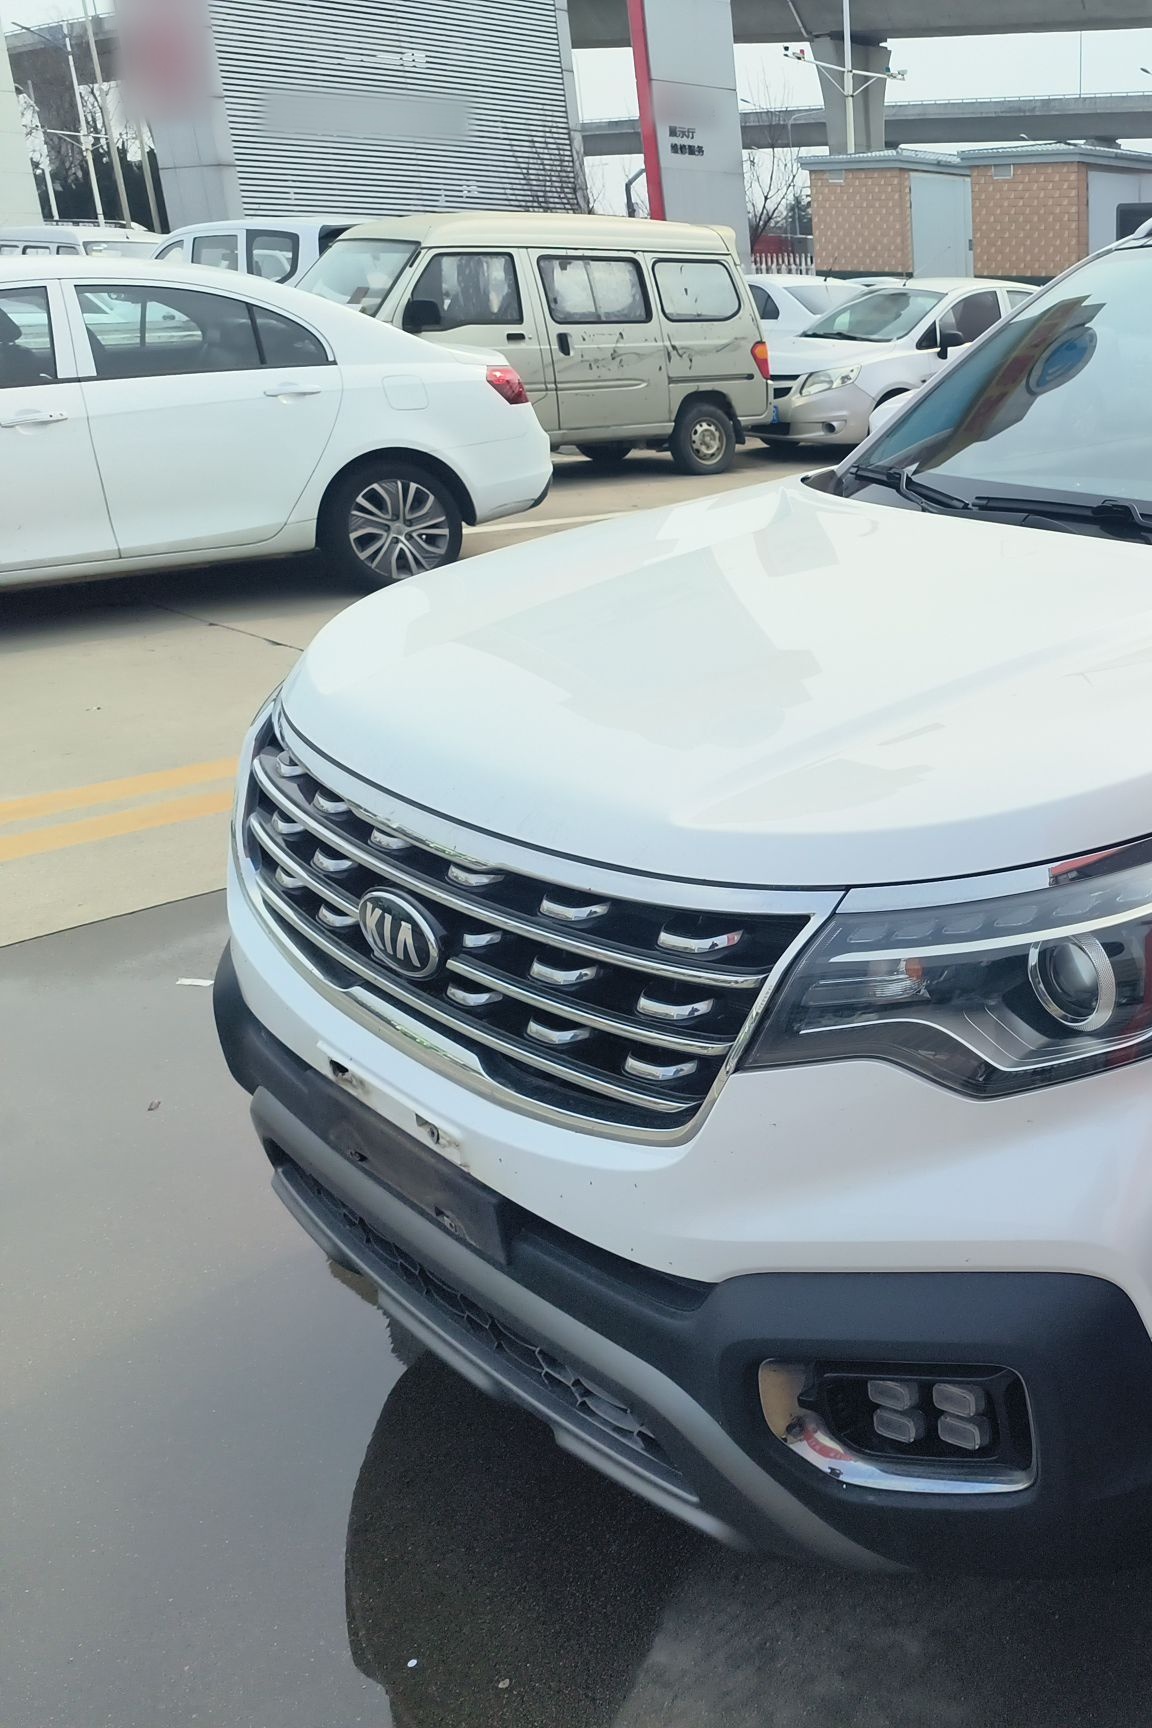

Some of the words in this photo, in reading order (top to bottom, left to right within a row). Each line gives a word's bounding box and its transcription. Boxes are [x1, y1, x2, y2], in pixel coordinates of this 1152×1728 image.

[668, 125, 696, 139] 展示厅
[670, 143, 704, 156] 维修服务
[366, 901, 421, 968] KIA
